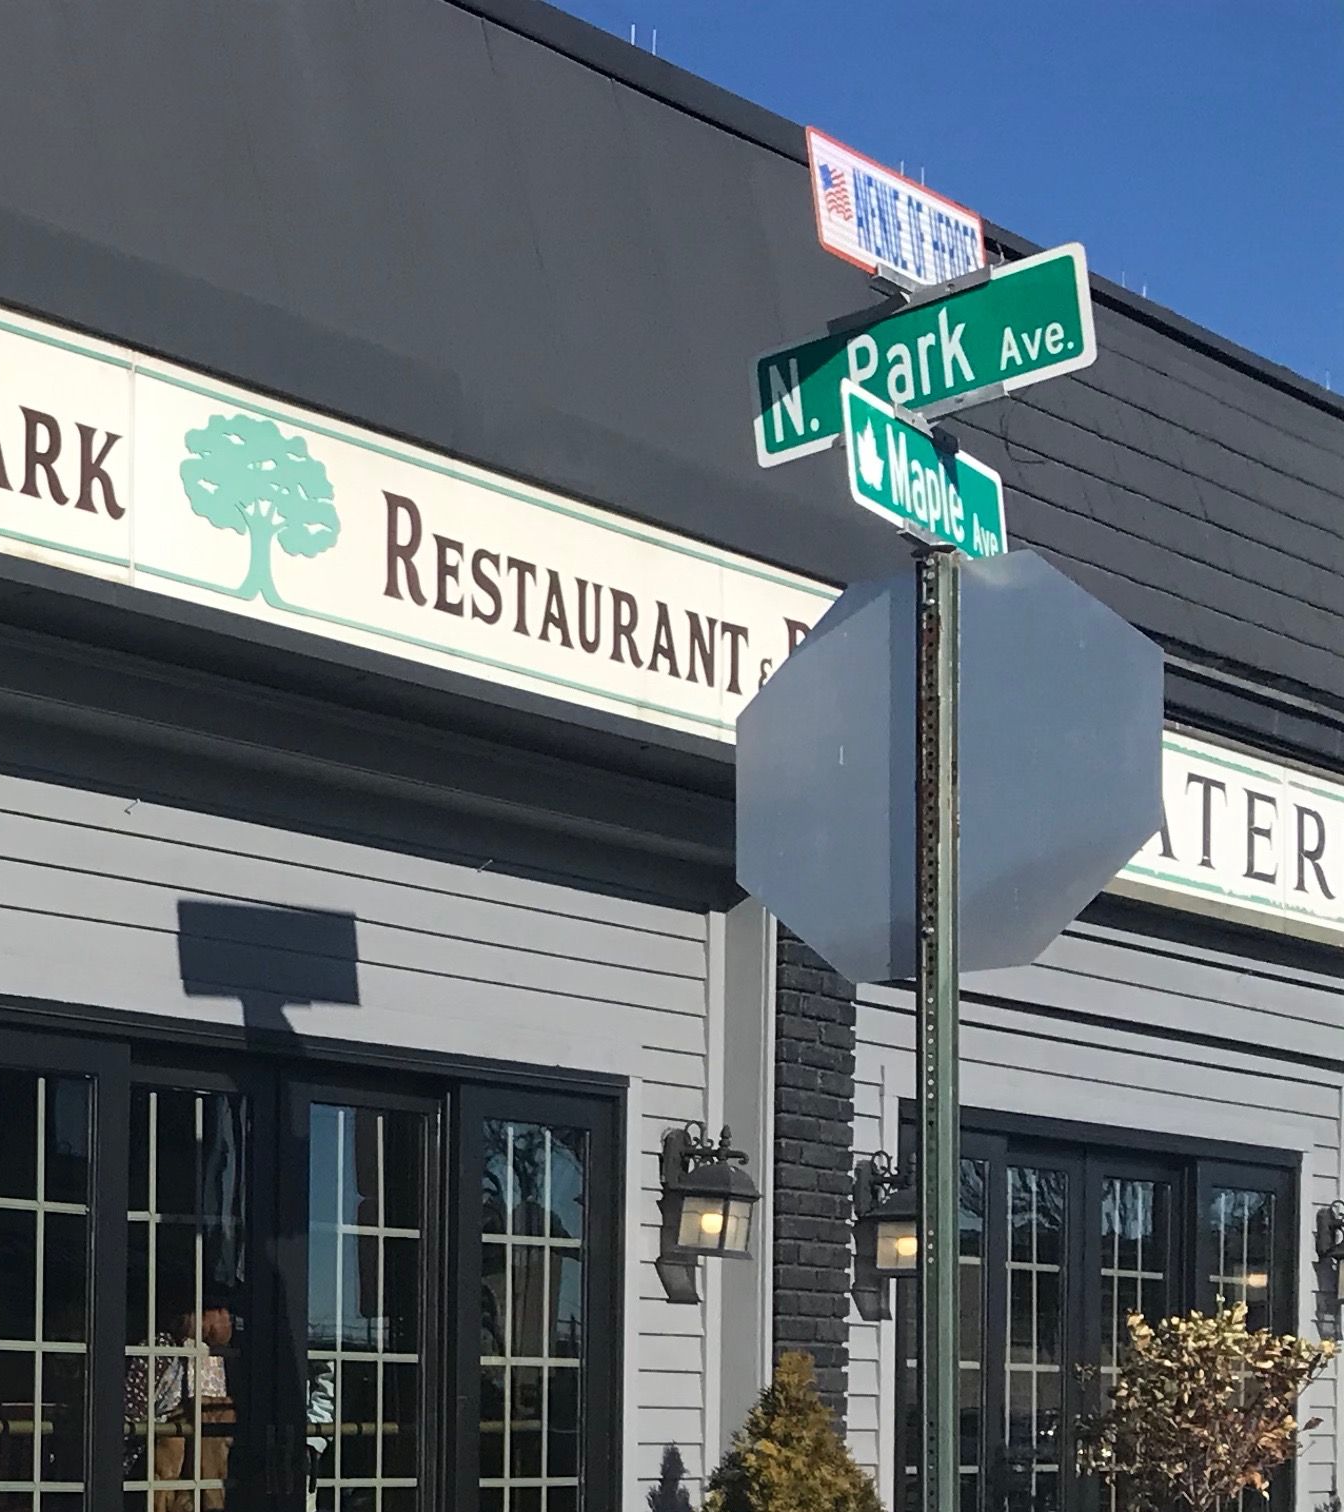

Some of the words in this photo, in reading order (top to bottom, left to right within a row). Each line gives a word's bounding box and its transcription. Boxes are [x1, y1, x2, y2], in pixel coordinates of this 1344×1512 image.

[769, 358, 819, 443] N.
[847, 307, 975, 405] Park
[1000, 322, 1074, 371] Ave.
[886, 423, 966, 543] Maple
[381, 489, 749, 695] RESTAURANT
